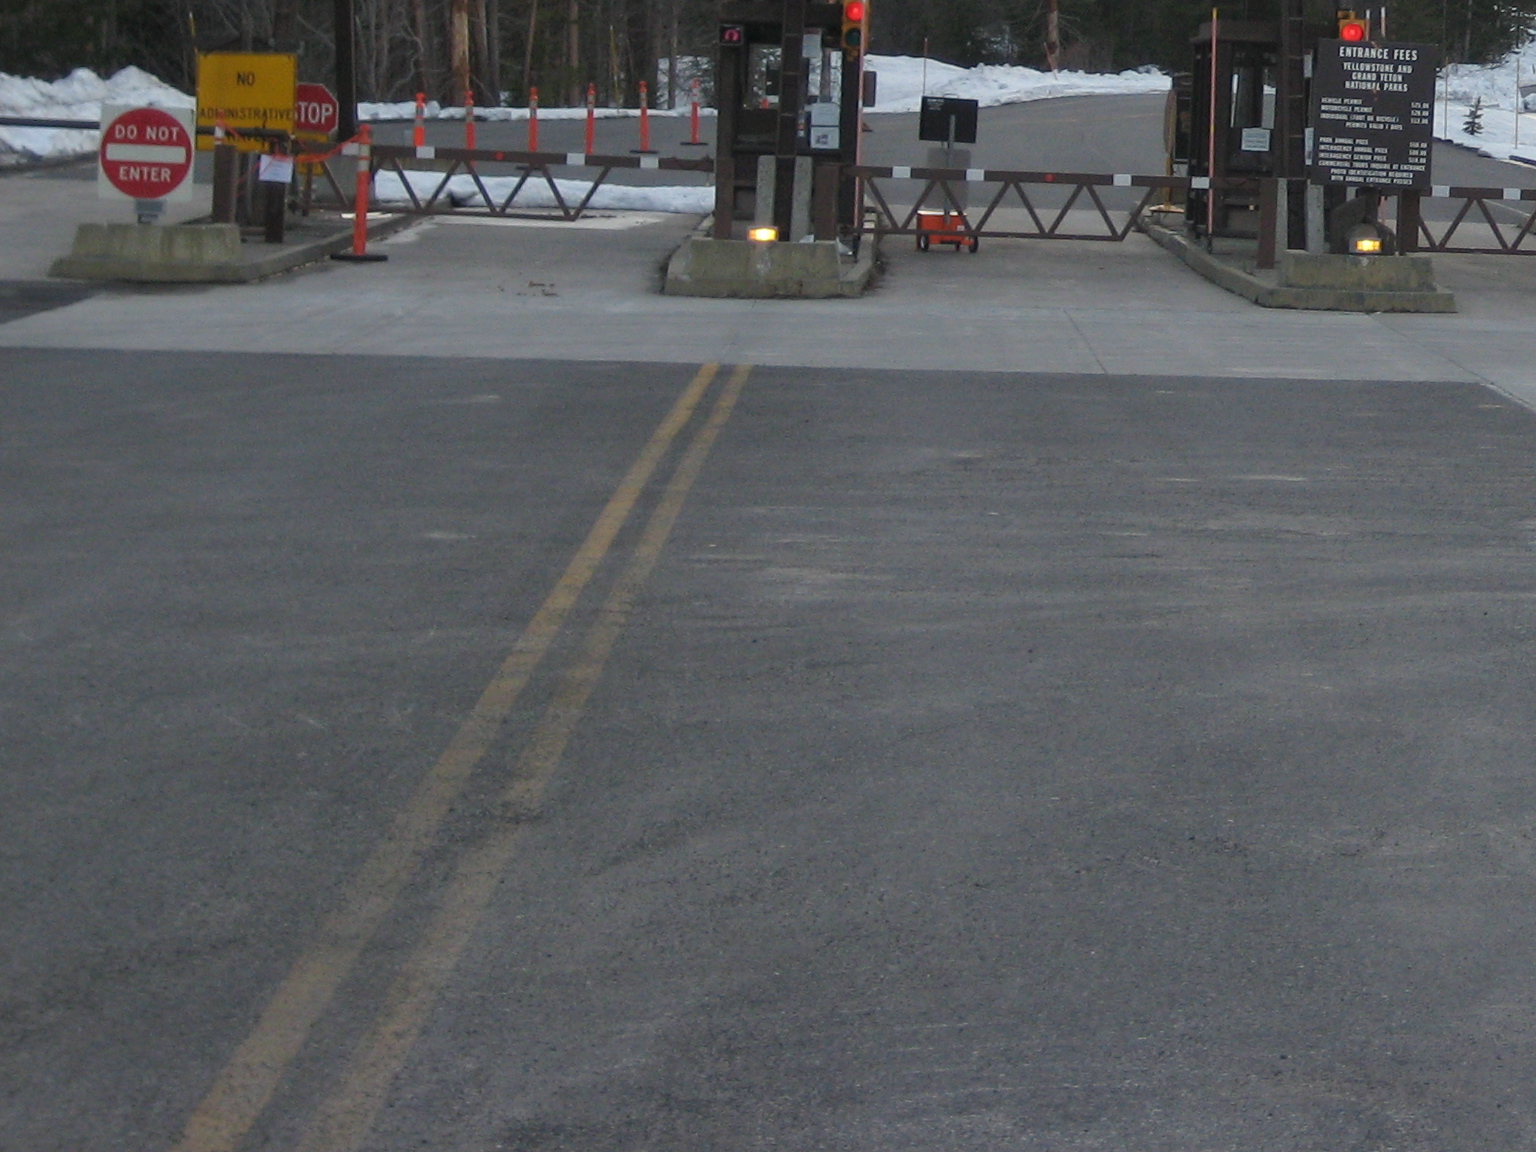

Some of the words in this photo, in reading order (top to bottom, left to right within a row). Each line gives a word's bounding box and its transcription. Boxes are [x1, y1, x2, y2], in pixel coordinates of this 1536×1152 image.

[1340, 46, 1389, 60] ENTRANCE
[1394, 50, 1418, 61] FEES
[1342, 62, 1394, 72] YELLOWSTONE
[1397, 64, 1413, 74] AND
[236, 72, 256, 86] NO
[1352, 72, 1376, 81] GRAND
[1380, 73, 1402, 82] TETON
[1345, 80, 1380, 90] NATIONAL
[1384, 83, 1408, 92] PARKS
[294, 102, 333, 124] TOP
[115, 124, 137, 140] DO
[146, 126, 180, 141] NOT
[119, 166, 171, 182] ENTER
